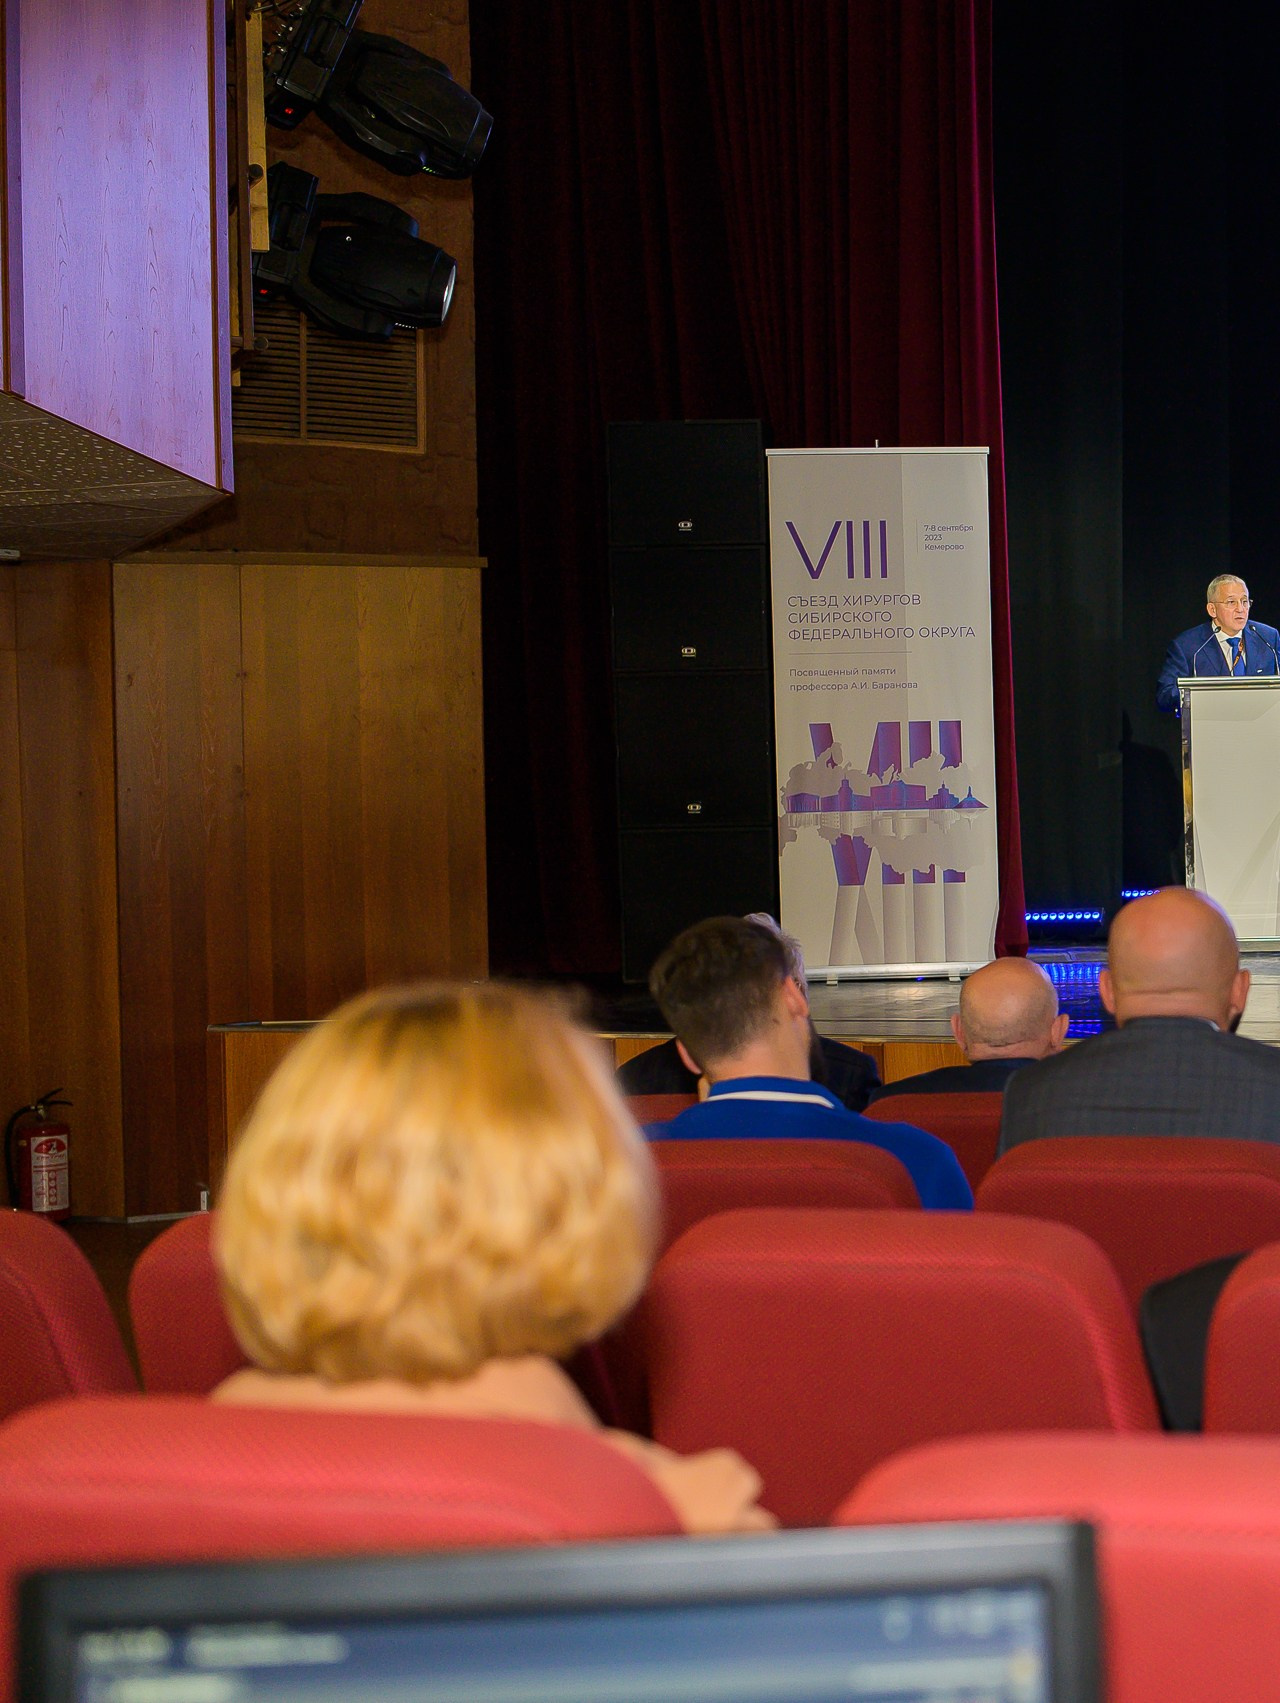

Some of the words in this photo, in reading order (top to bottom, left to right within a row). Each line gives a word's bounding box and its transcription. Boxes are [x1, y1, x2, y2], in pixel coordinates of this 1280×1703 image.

[924, 524, 936, 532] 7-8
[937, 524, 974, 533] сентября
[924, 534, 943, 542] 2023
[785, 520, 888, 579] VIII
[924, 543, 965, 552] Кемерово
[787, 595, 839, 608] СЪЕЗД
[843, 594, 921, 606] ХИРУРГОВ
[788, 611, 892, 624] СИБИРСКОГО
[788, 627, 915, 641] ФЕДЕРАЛЬНОГО
[918, 626, 976, 638] ОКРУГА
[789, 667, 859, 678] Посвященный
[861, 667, 896, 676] памяти
[789, 682, 849, 692] профессора
[851, 681, 870, 690] А.И.
[872, 681, 918, 690] Баранова
